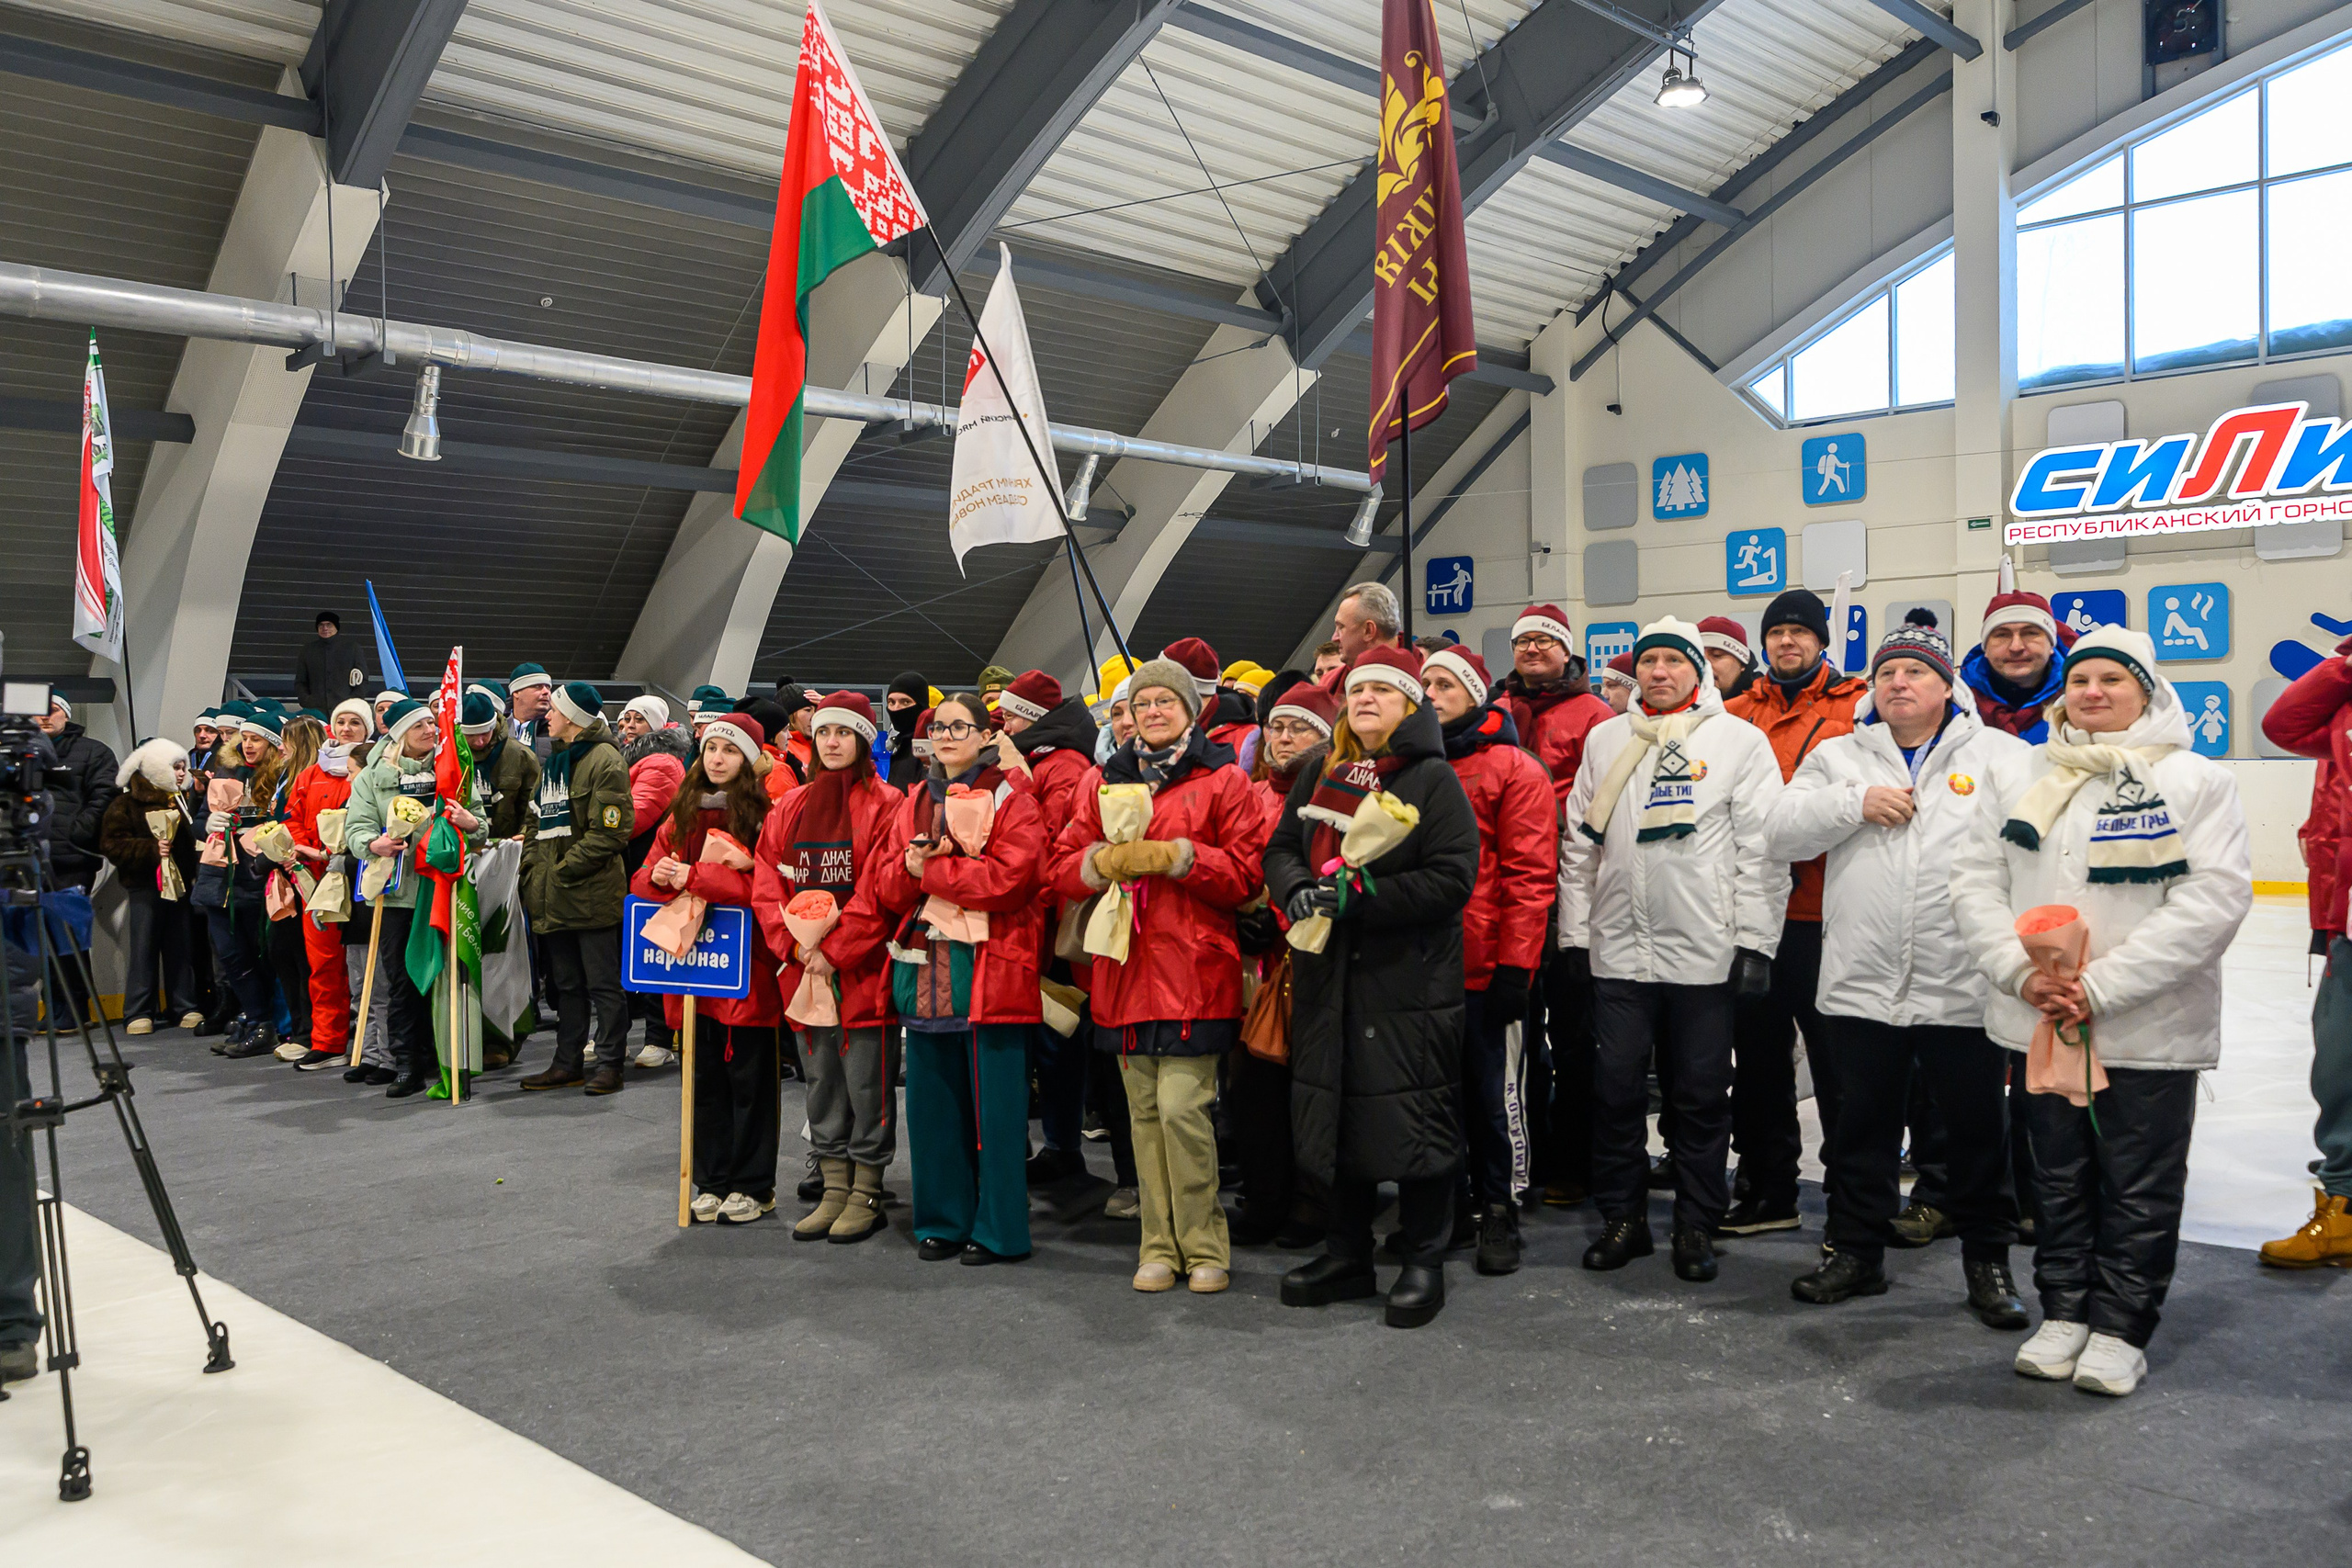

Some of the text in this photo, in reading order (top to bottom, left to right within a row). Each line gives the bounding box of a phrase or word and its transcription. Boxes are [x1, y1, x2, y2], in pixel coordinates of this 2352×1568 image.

[2013, 405, 2352, 513] СИЛИ
[2008, 500, 2352, 541] РЕСПУБЛИКАНСКИЙ ГОРНО
